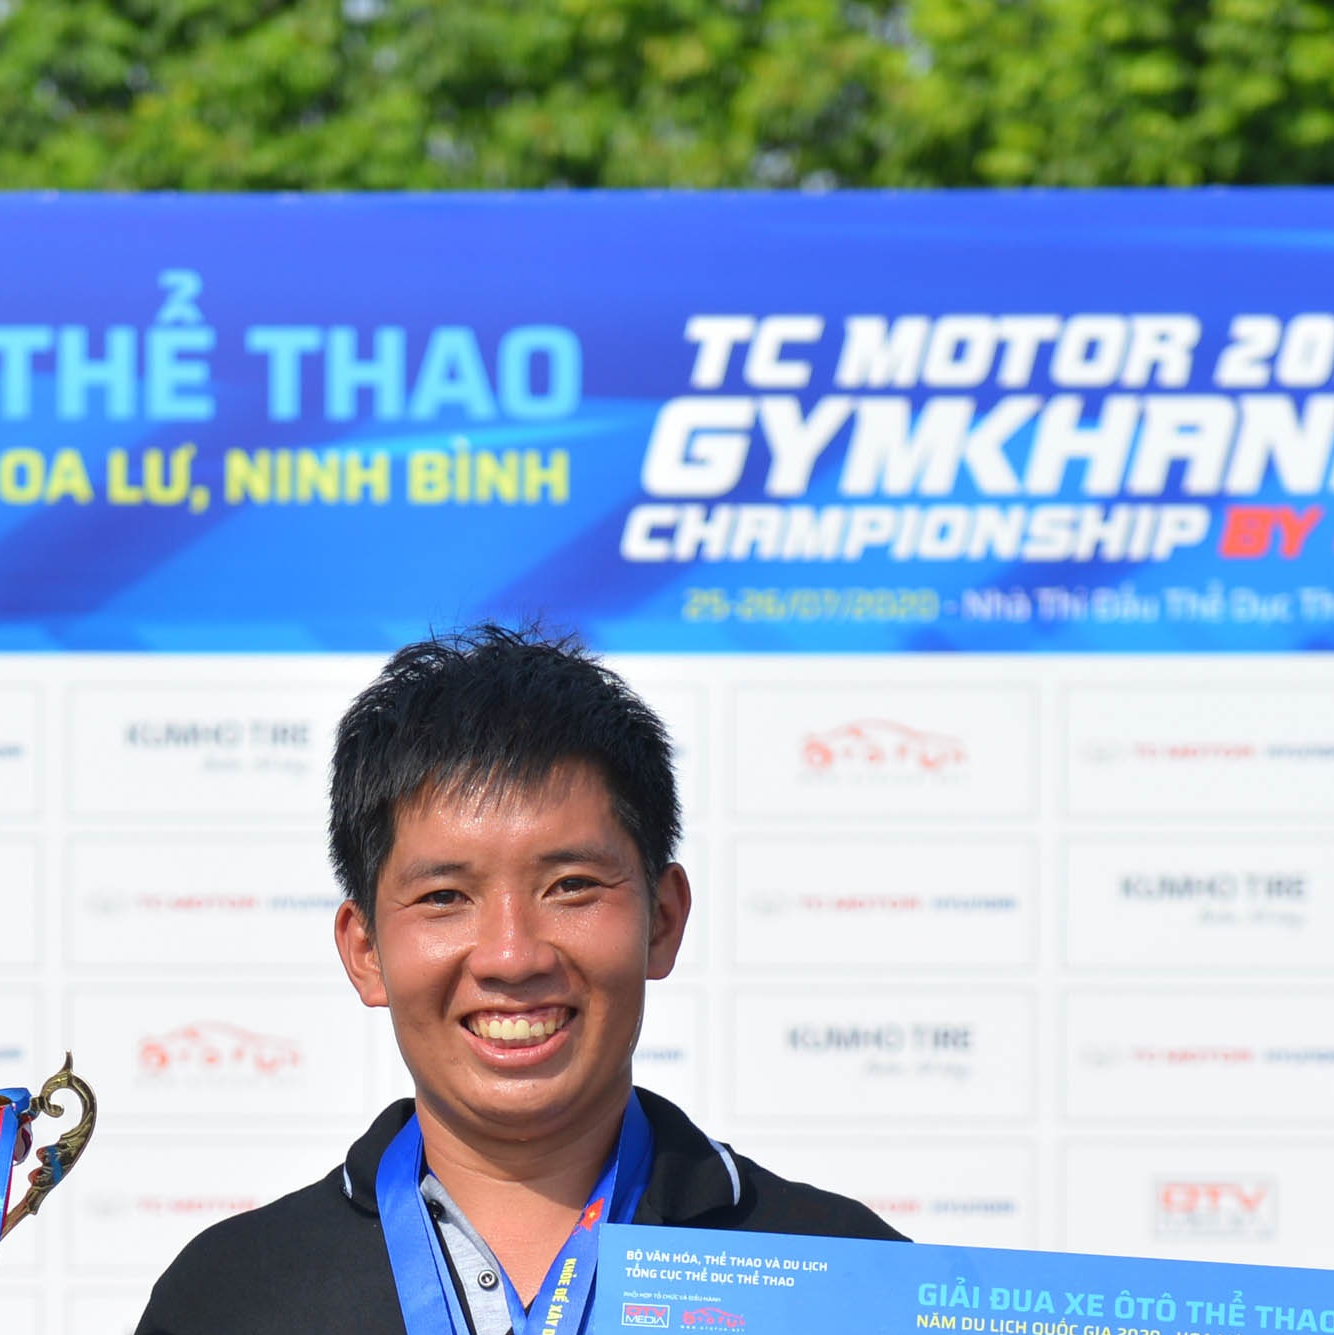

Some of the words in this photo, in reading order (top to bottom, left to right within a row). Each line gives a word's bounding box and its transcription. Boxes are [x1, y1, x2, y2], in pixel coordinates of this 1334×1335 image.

[246, 325, 584, 422] THAO
[683, 314, 825, 388] TC
[834, 314, 1202, 388] MOTOR
[106, 442, 211, 514] LƯ,
[224, 448, 391, 504] NINH
[407, 437, 569, 504] BÌNH
[620, 504, 1211, 562] CHAMPIONSHIP
[1219, 505, 1323, 558] BY
[626, 1249, 643, 1261] BỘ
[646, 1251, 670, 1262] VĂN
[673, 1252, 701, 1265] HÓA,
[704, 1251, 726, 1266] THỂ
[730, 1257, 762, 1268] THAO
[764, 1257, 780, 1269] VÀ
[784, 1260, 800, 1270] DU
[802, 1261, 827, 1273] LỊCH
[626, 1263, 657, 1279] TỔNG
[660, 1269, 682, 1281] CỤC
[685, 1267, 708, 1282] THỂ
[711, 1273, 734, 1284] DỤC
[737, 1270, 759, 1285] THỂ
[762, 1276, 795, 1287] THAO
[625, 1314, 666, 1327] MEDIA
[916, 1311, 957, 1330] NĂM
[961, 1317, 986, 1332] DU
[918, 1275, 980, 1308] GIẢI
[989, 1287, 1055, 1314] ĐUA
[1064, 1292, 1104, 1317] XE
[1114, 1289, 1176, 1322] ÔTÔ
[1186, 1290, 1245, 1327] THỂ
